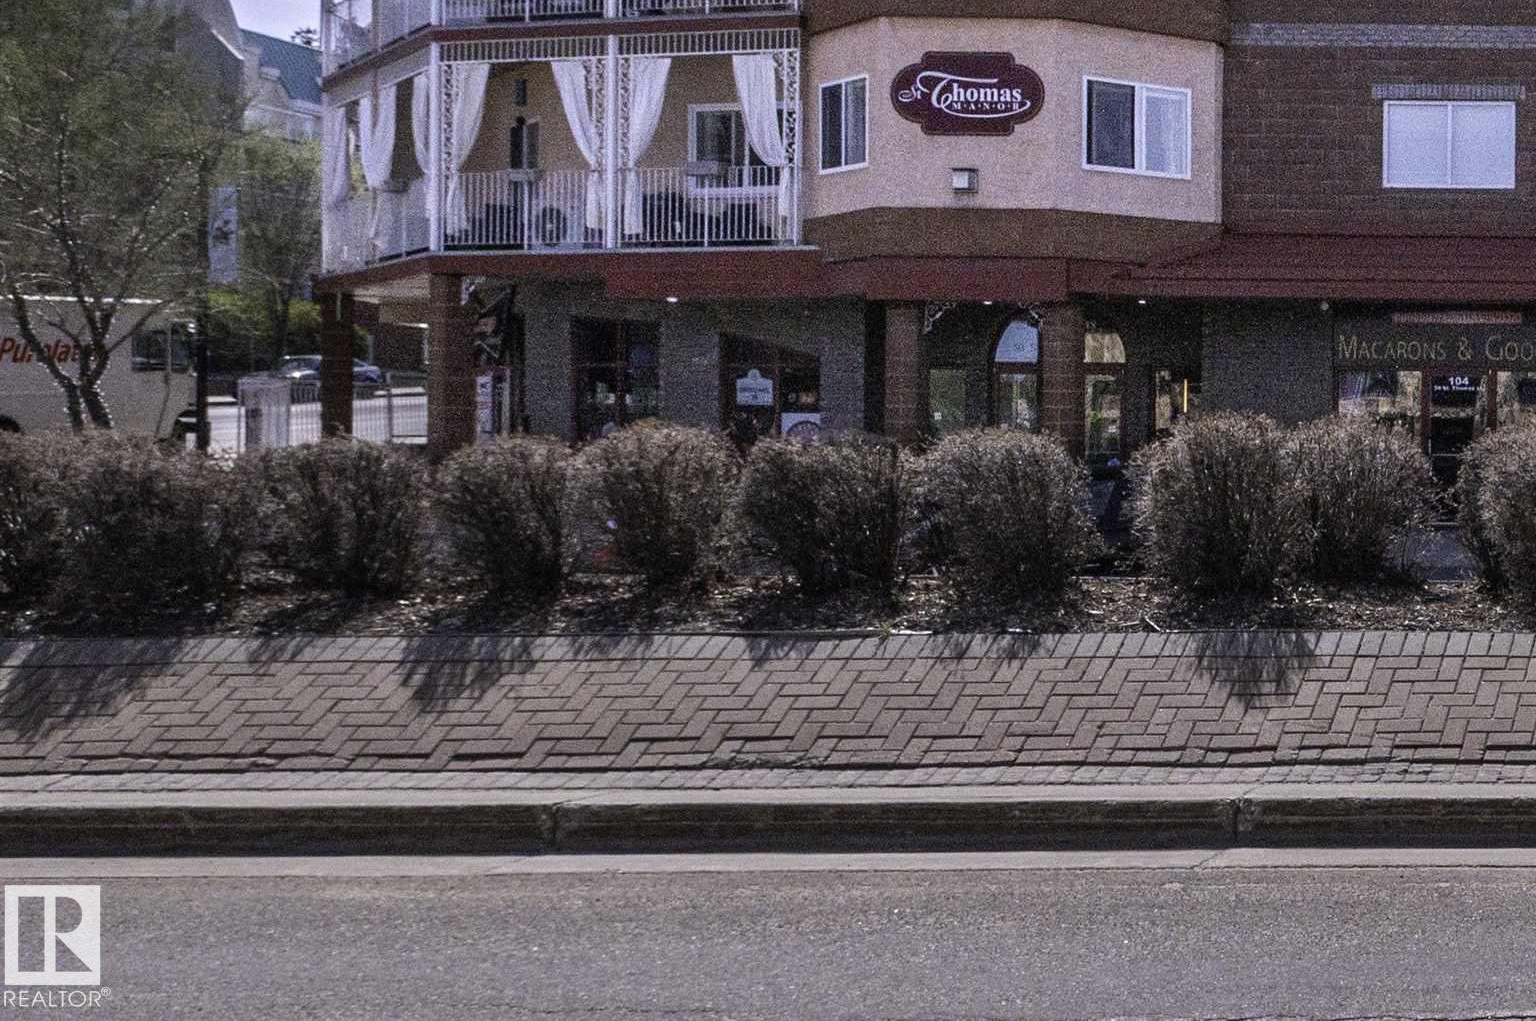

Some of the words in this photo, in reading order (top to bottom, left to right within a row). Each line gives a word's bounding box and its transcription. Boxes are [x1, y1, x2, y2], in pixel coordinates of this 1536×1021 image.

[898, 83, 922, 103] St
[916, 70, 1023, 109] Thomas
[1457, 336, 1473, 361] &
[1448, 376, 1470, 386] 104
